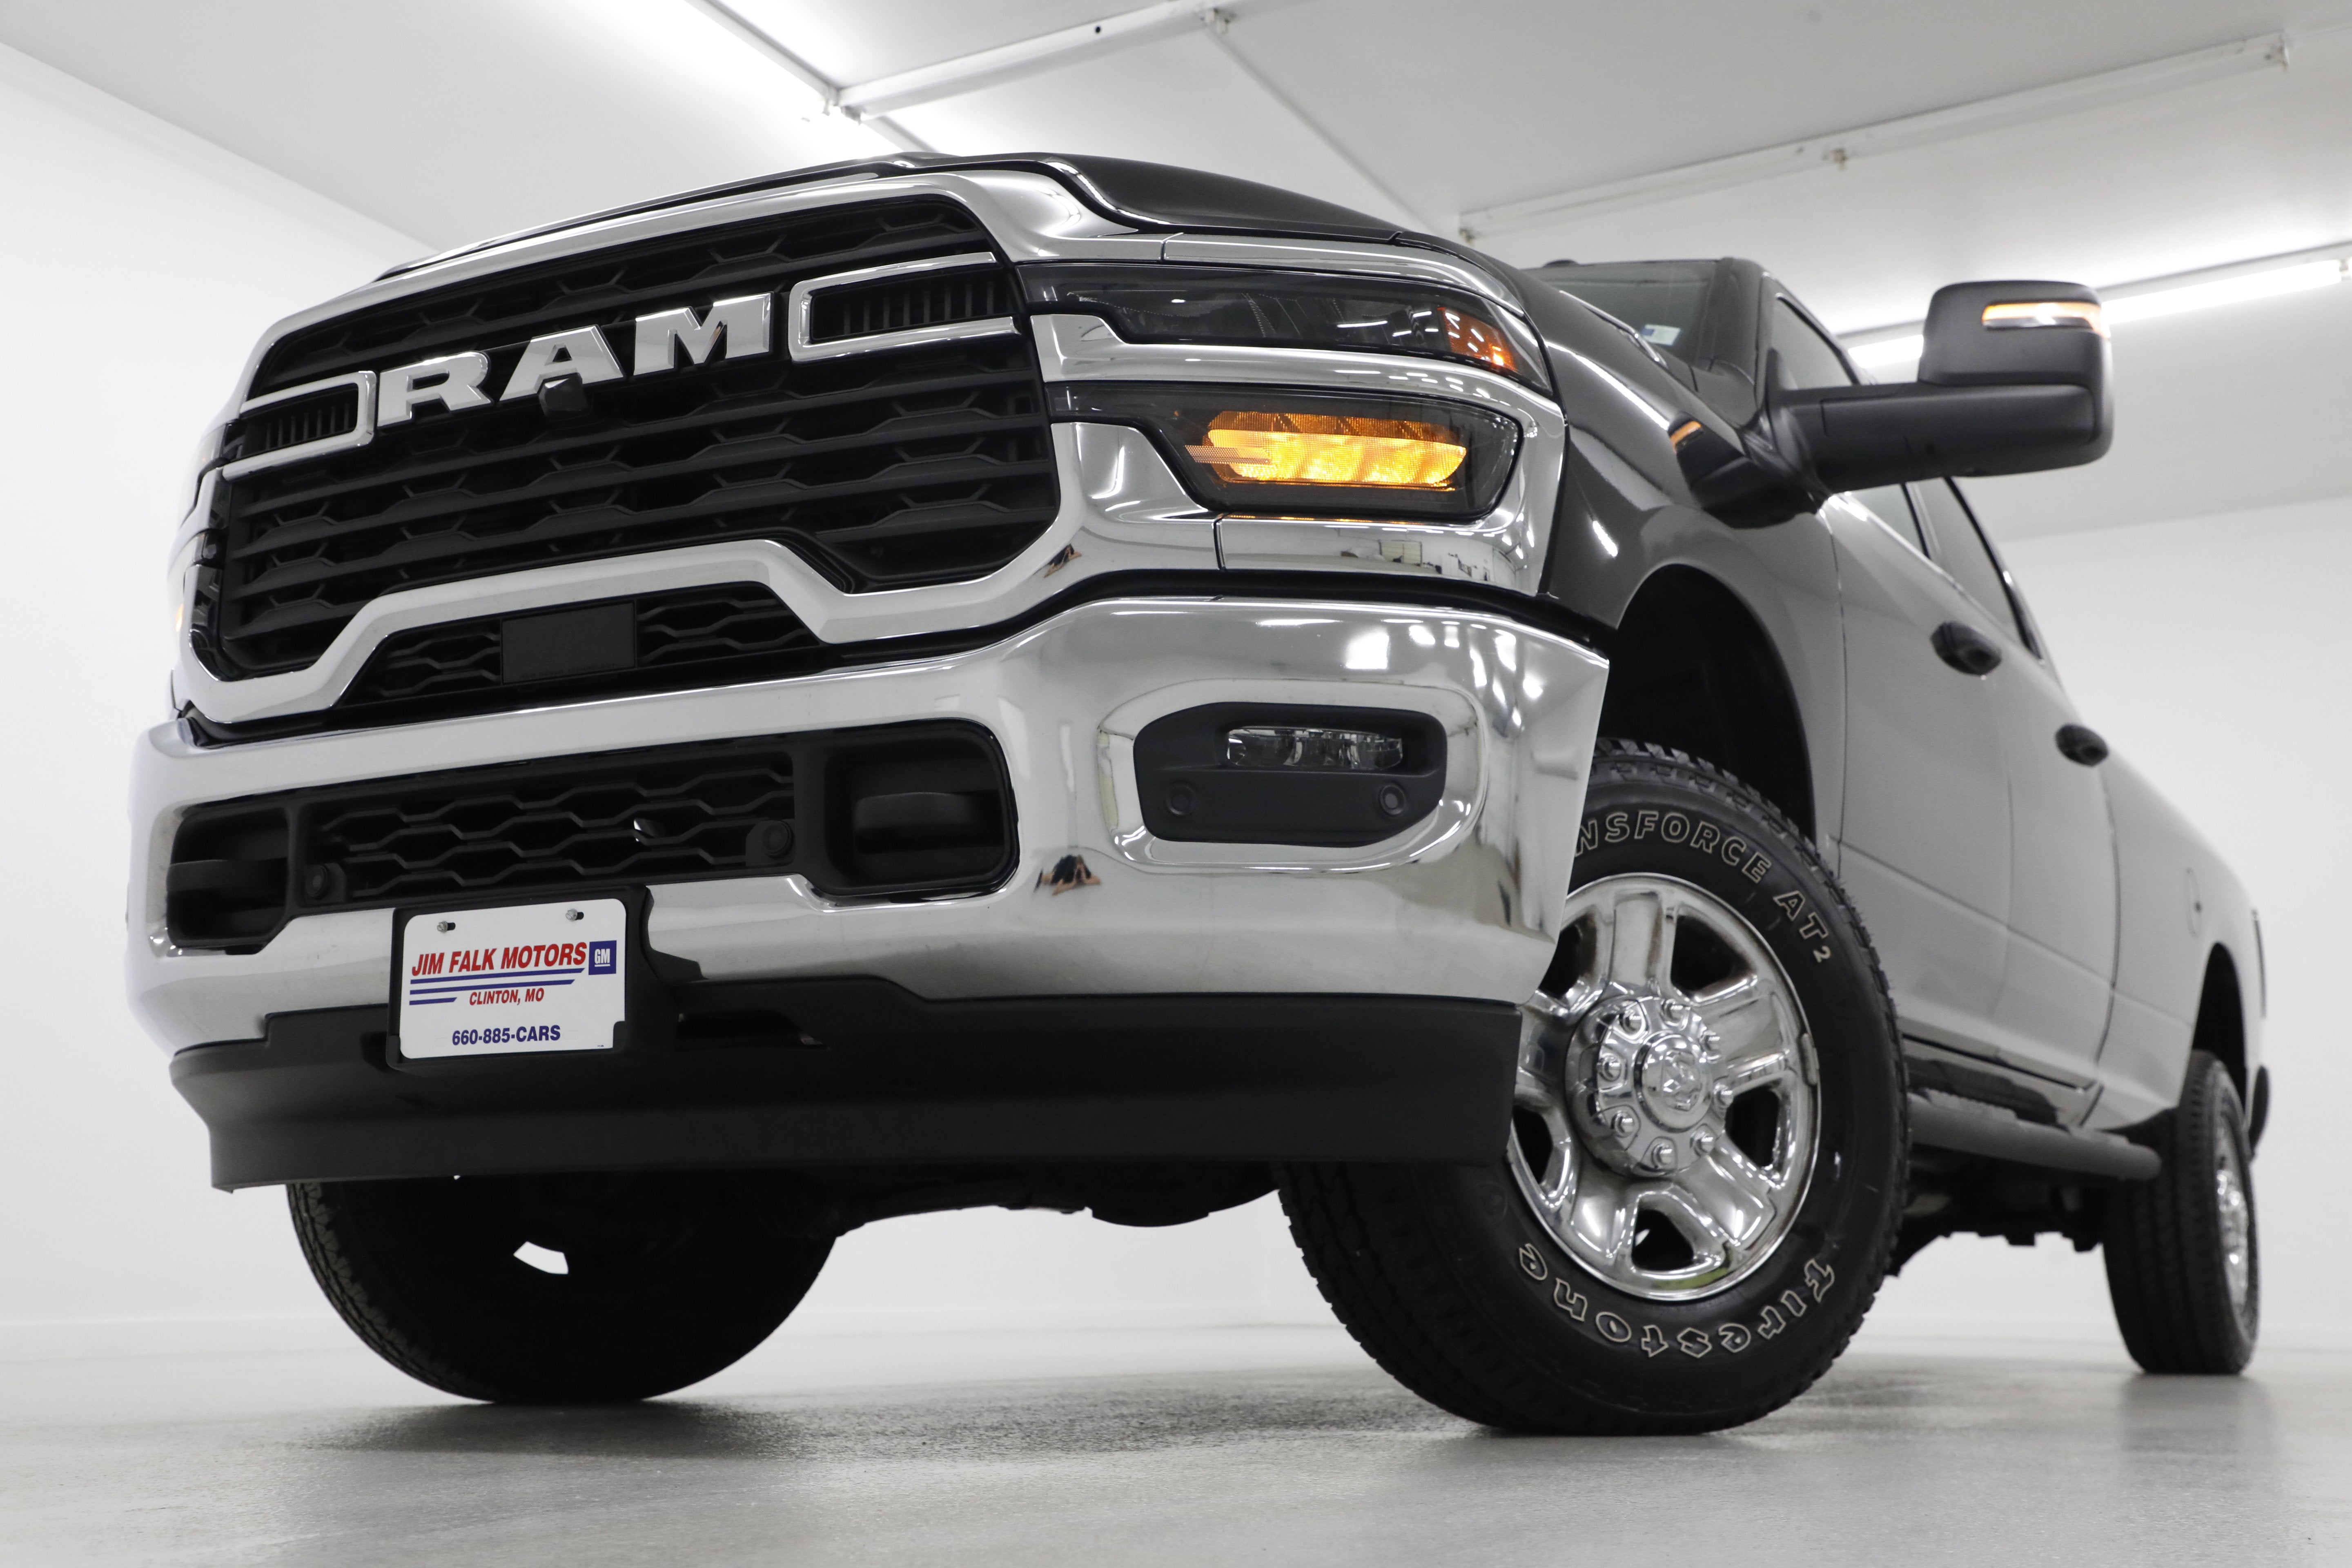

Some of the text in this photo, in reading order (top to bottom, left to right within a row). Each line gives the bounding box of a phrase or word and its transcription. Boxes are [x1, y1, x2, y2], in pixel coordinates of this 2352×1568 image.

[377, 291, 774, 427] RAM
[1575, 810, 1771, 884] NSFORCE
[412, 942, 587, 976] JIM FALK MOTORS
[594, 948, 610, 964] GM
[470, 988, 544, 1006] CLINTON, MO
[452, 1025, 561, 1046] 660-885-CARS
[1519, 1243, 1835, 1358] Firestone
